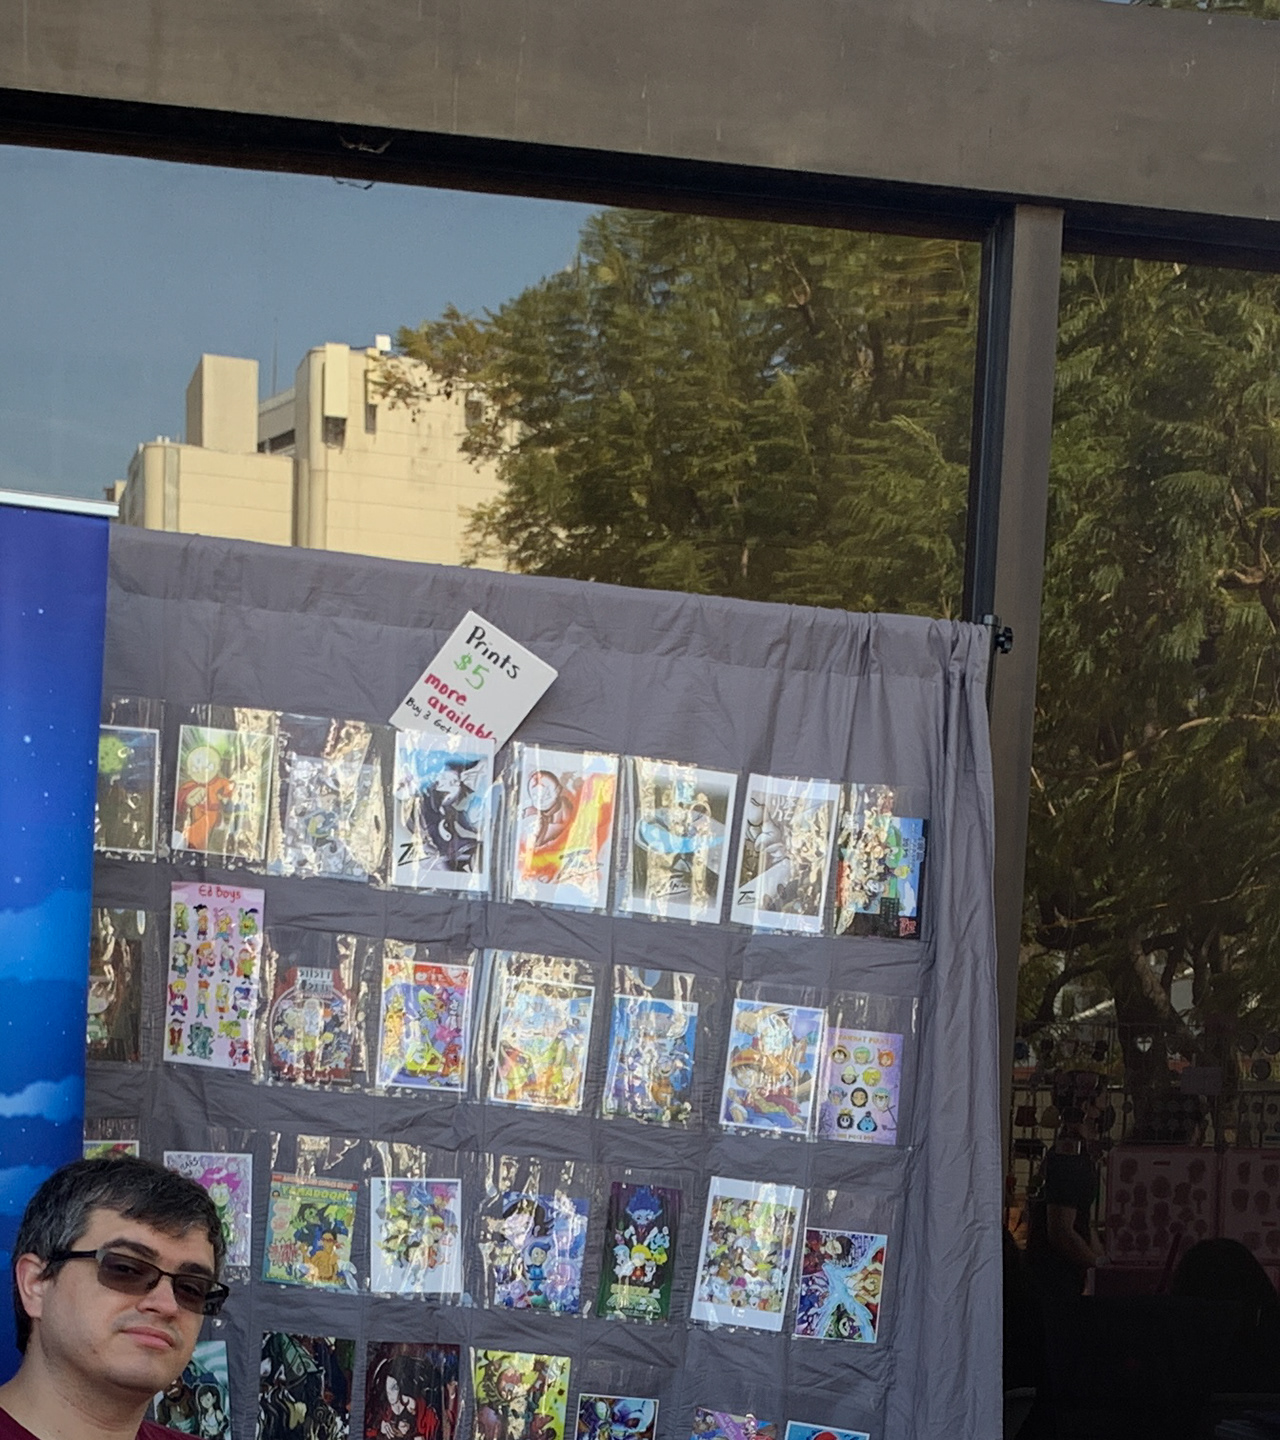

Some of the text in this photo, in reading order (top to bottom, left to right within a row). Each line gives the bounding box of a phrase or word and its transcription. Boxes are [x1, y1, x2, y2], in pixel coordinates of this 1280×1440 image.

[465, 625, 519, 679] Prints
[424, 673, 467, 706] more
[453, 653, 489, 690] $5
[406, 697, 452, 733] Buy 3 Get
[198, 885, 241, 902] Ed Boys
